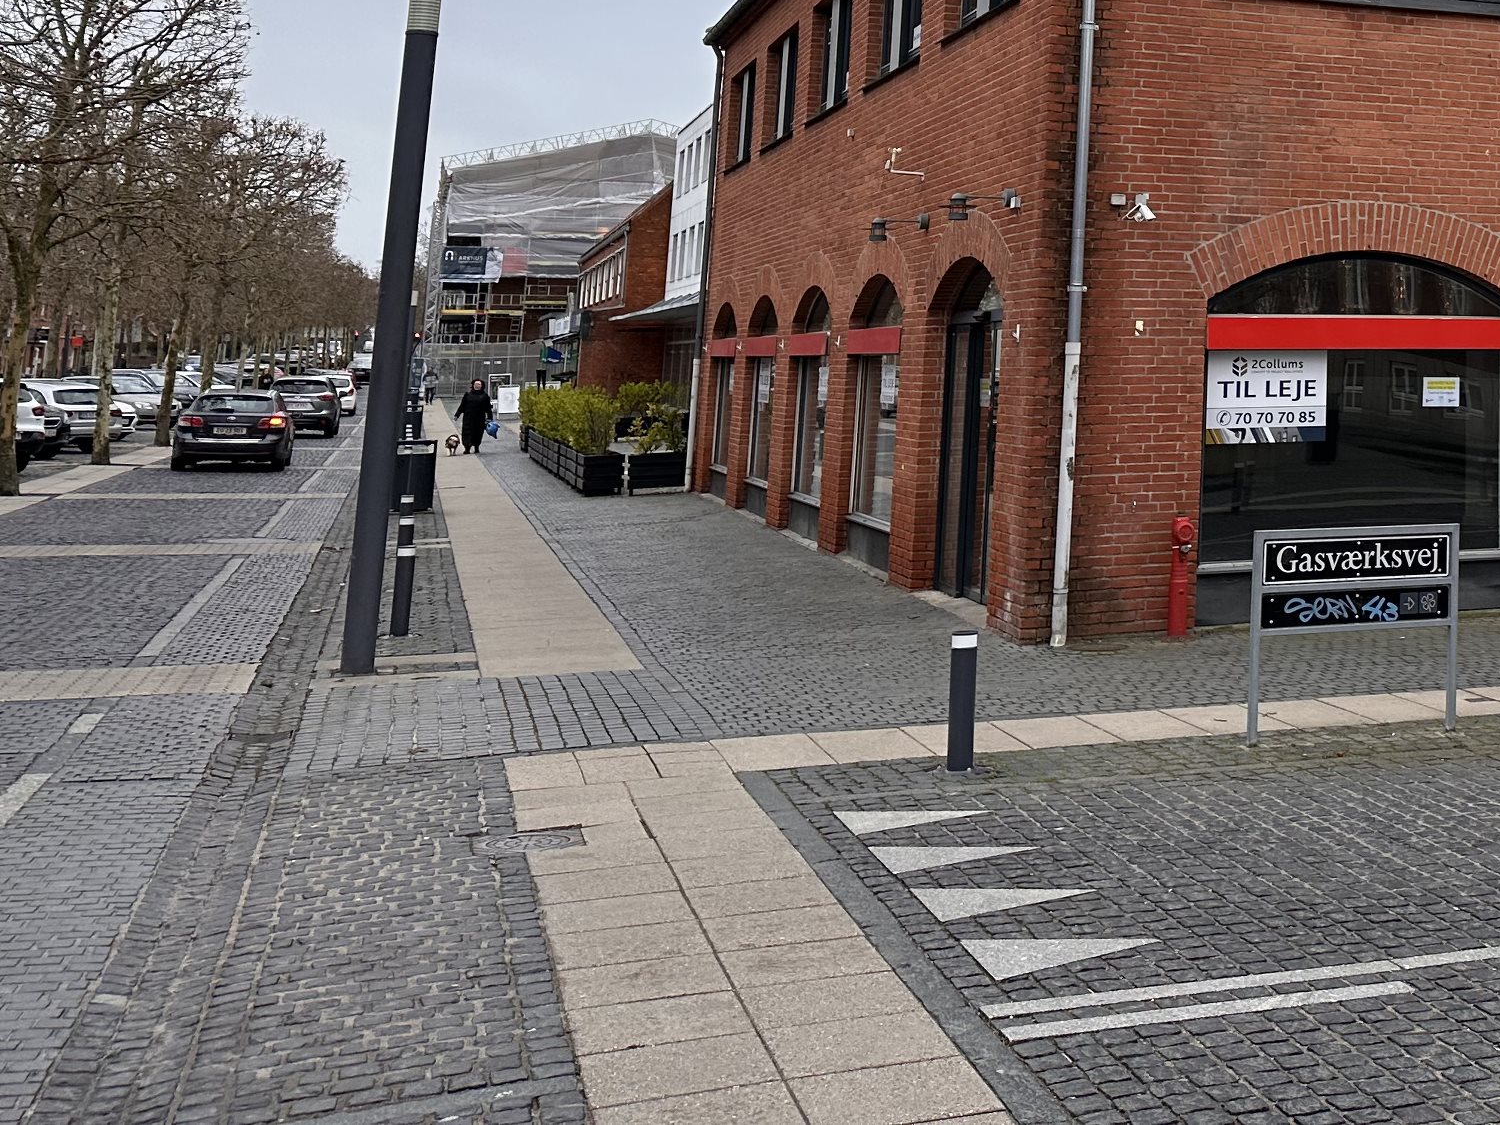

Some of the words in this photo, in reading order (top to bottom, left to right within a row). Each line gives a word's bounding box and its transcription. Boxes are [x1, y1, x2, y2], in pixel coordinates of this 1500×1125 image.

[1251, 359, 1304, 369] 2Collums
[1217, 380, 1257, 399] TIL
[1265, 379, 1317, 402] LEJE
[1235, 412, 1252, 424] 70
[1257, 412, 1274, 424] 70
[1278, 411, 1295, 424] 70
[1298, 410, 1316, 423] 85
[1276, 542, 1439, 574] Gasværksvej
